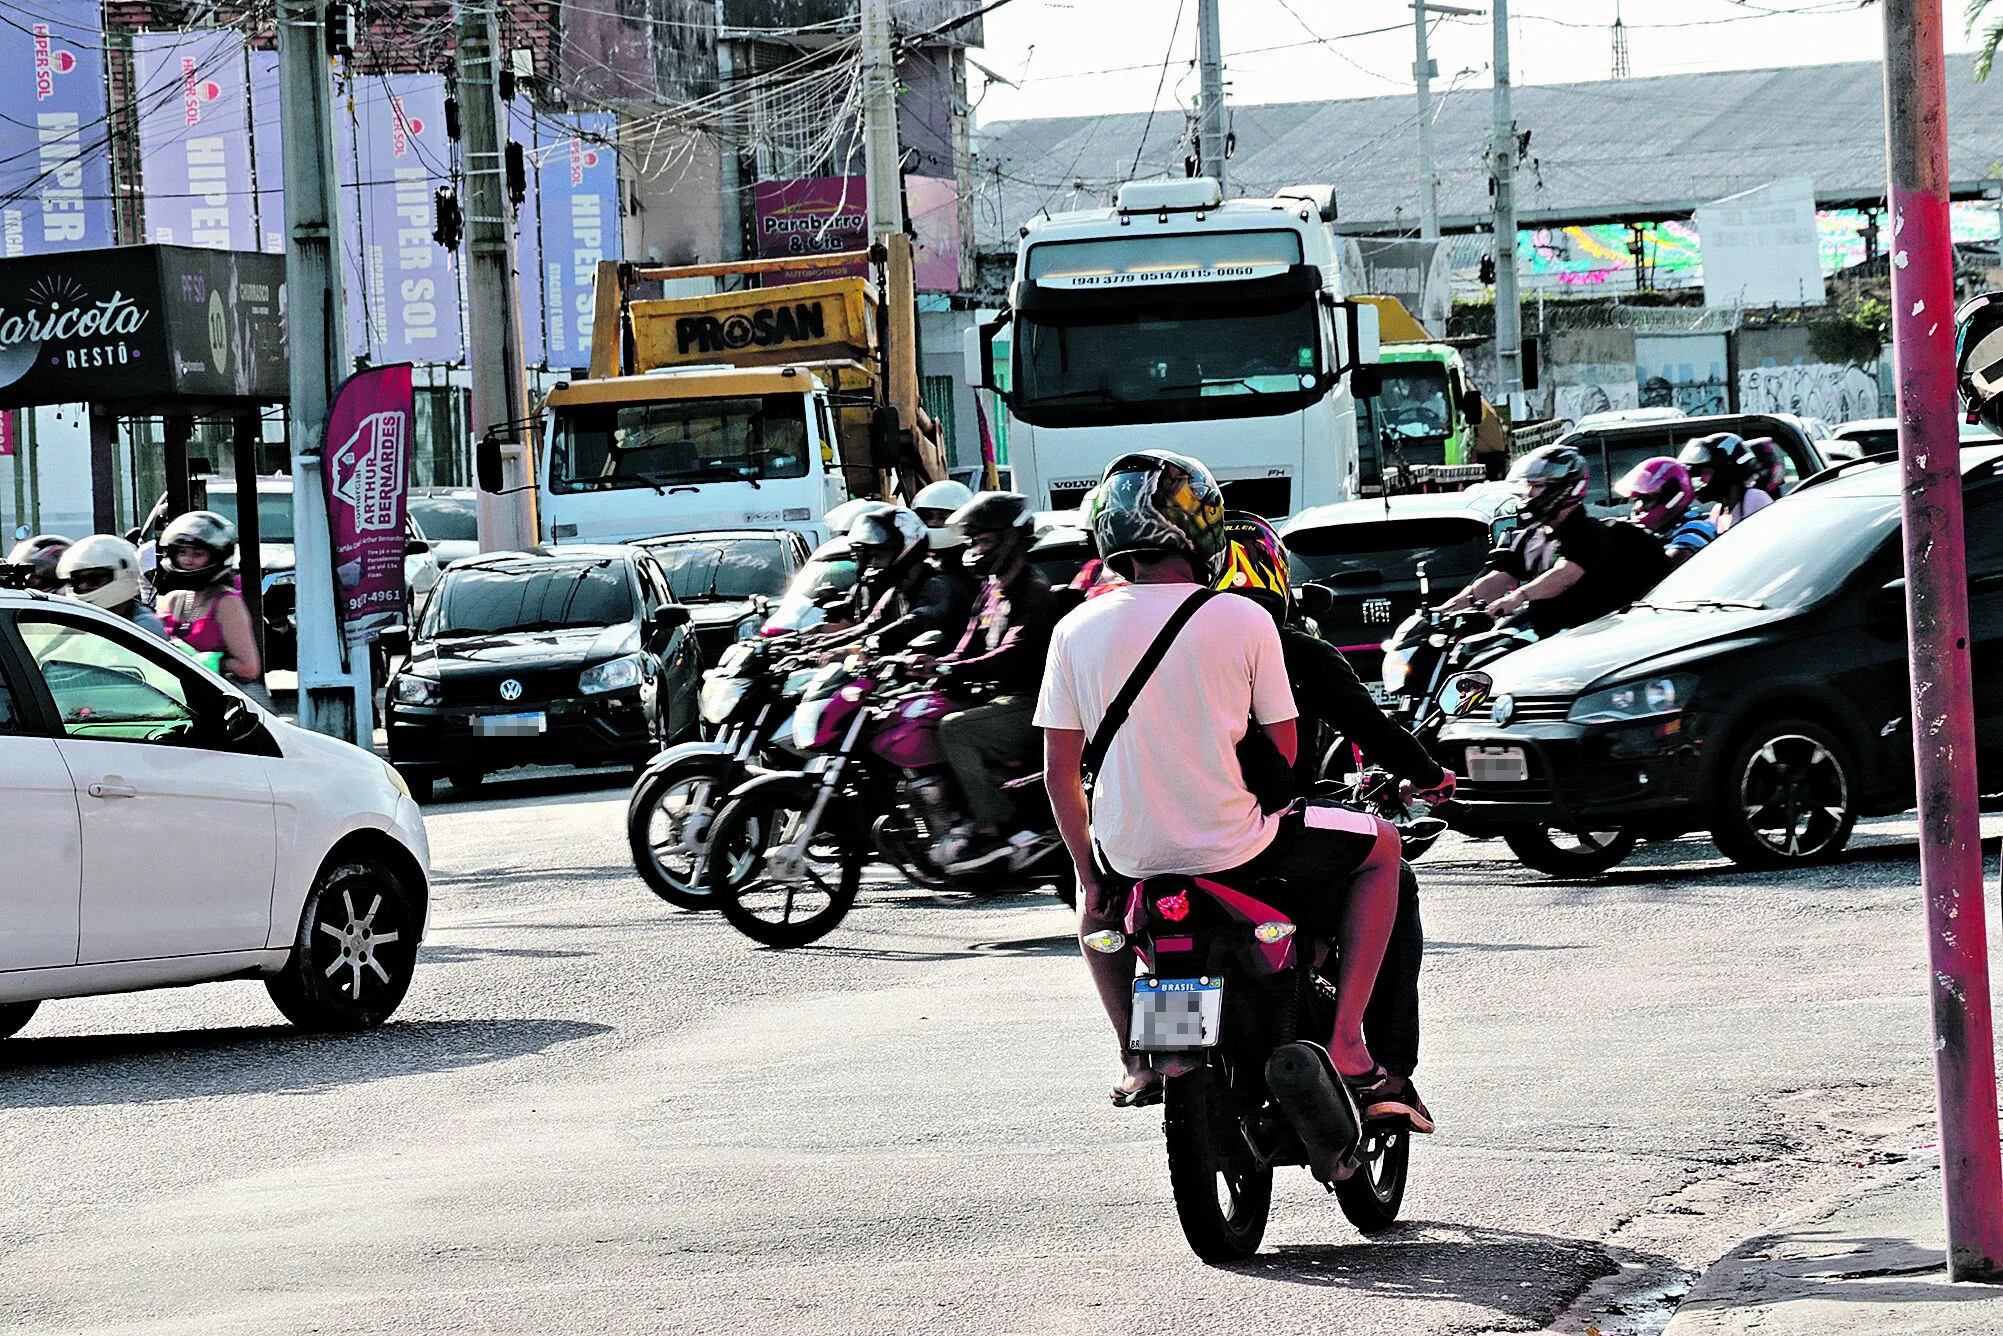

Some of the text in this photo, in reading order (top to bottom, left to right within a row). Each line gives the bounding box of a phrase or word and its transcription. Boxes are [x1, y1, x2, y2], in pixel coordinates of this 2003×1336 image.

[33, 24, 51, 99] HIPER SOL
[185, 98, 199, 126] SOL
[393, 134, 407, 157] SOL
[37, 112, 85, 242] HIPER
[572, 164, 582, 184] SOL
[763, 213, 864, 234] Parabarro
[394, 167, 437, 344] HIPER SOL
[789, 234, 844, 252] & Cia
[1103, 274, 1136, 285] 3779
[675, 301, 826, 355] PROSAN
[66, 341, 128, 369] RESTÔ
[378, 415, 396, 525] BERNARDES
[1267, 469, 1286, 477] FH
[364, 457, 377, 525] ARTHUR
[1053, 480, 1098, 490] VOLVO
[1161, 983, 1196, 992] BRASIL
